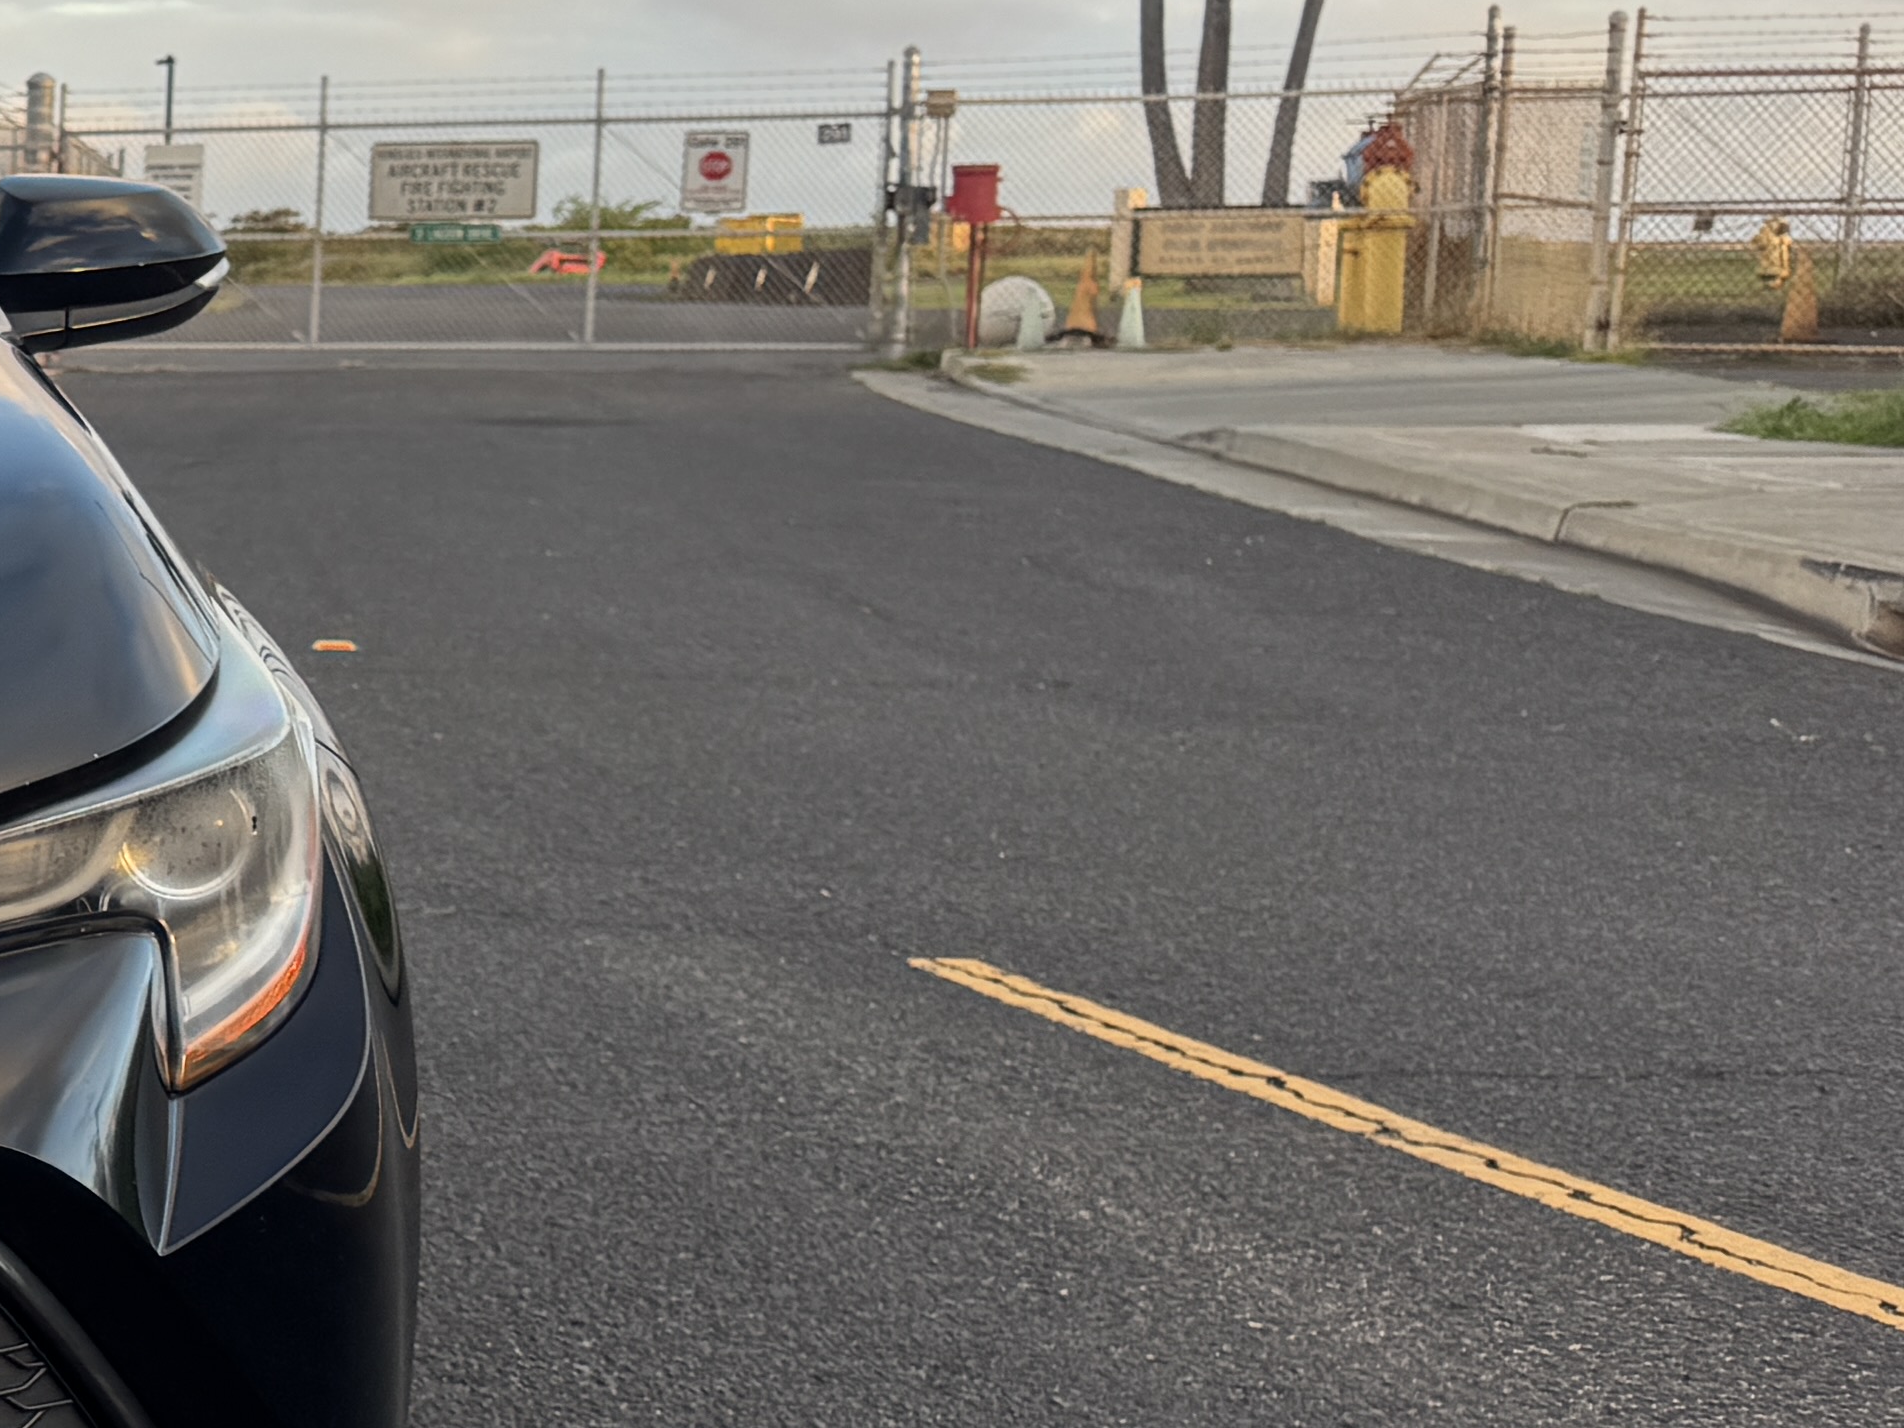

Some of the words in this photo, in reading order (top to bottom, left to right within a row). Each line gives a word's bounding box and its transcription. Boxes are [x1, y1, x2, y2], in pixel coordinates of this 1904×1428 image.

[388, 163, 458, 177] AIRCRAFT
[462, 161, 520, 177] RESCUE
[400, 181, 433, 196] FIRE
[437, 180, 505, 196] FIGHTING
[407, 198, 466, 213] STATION
